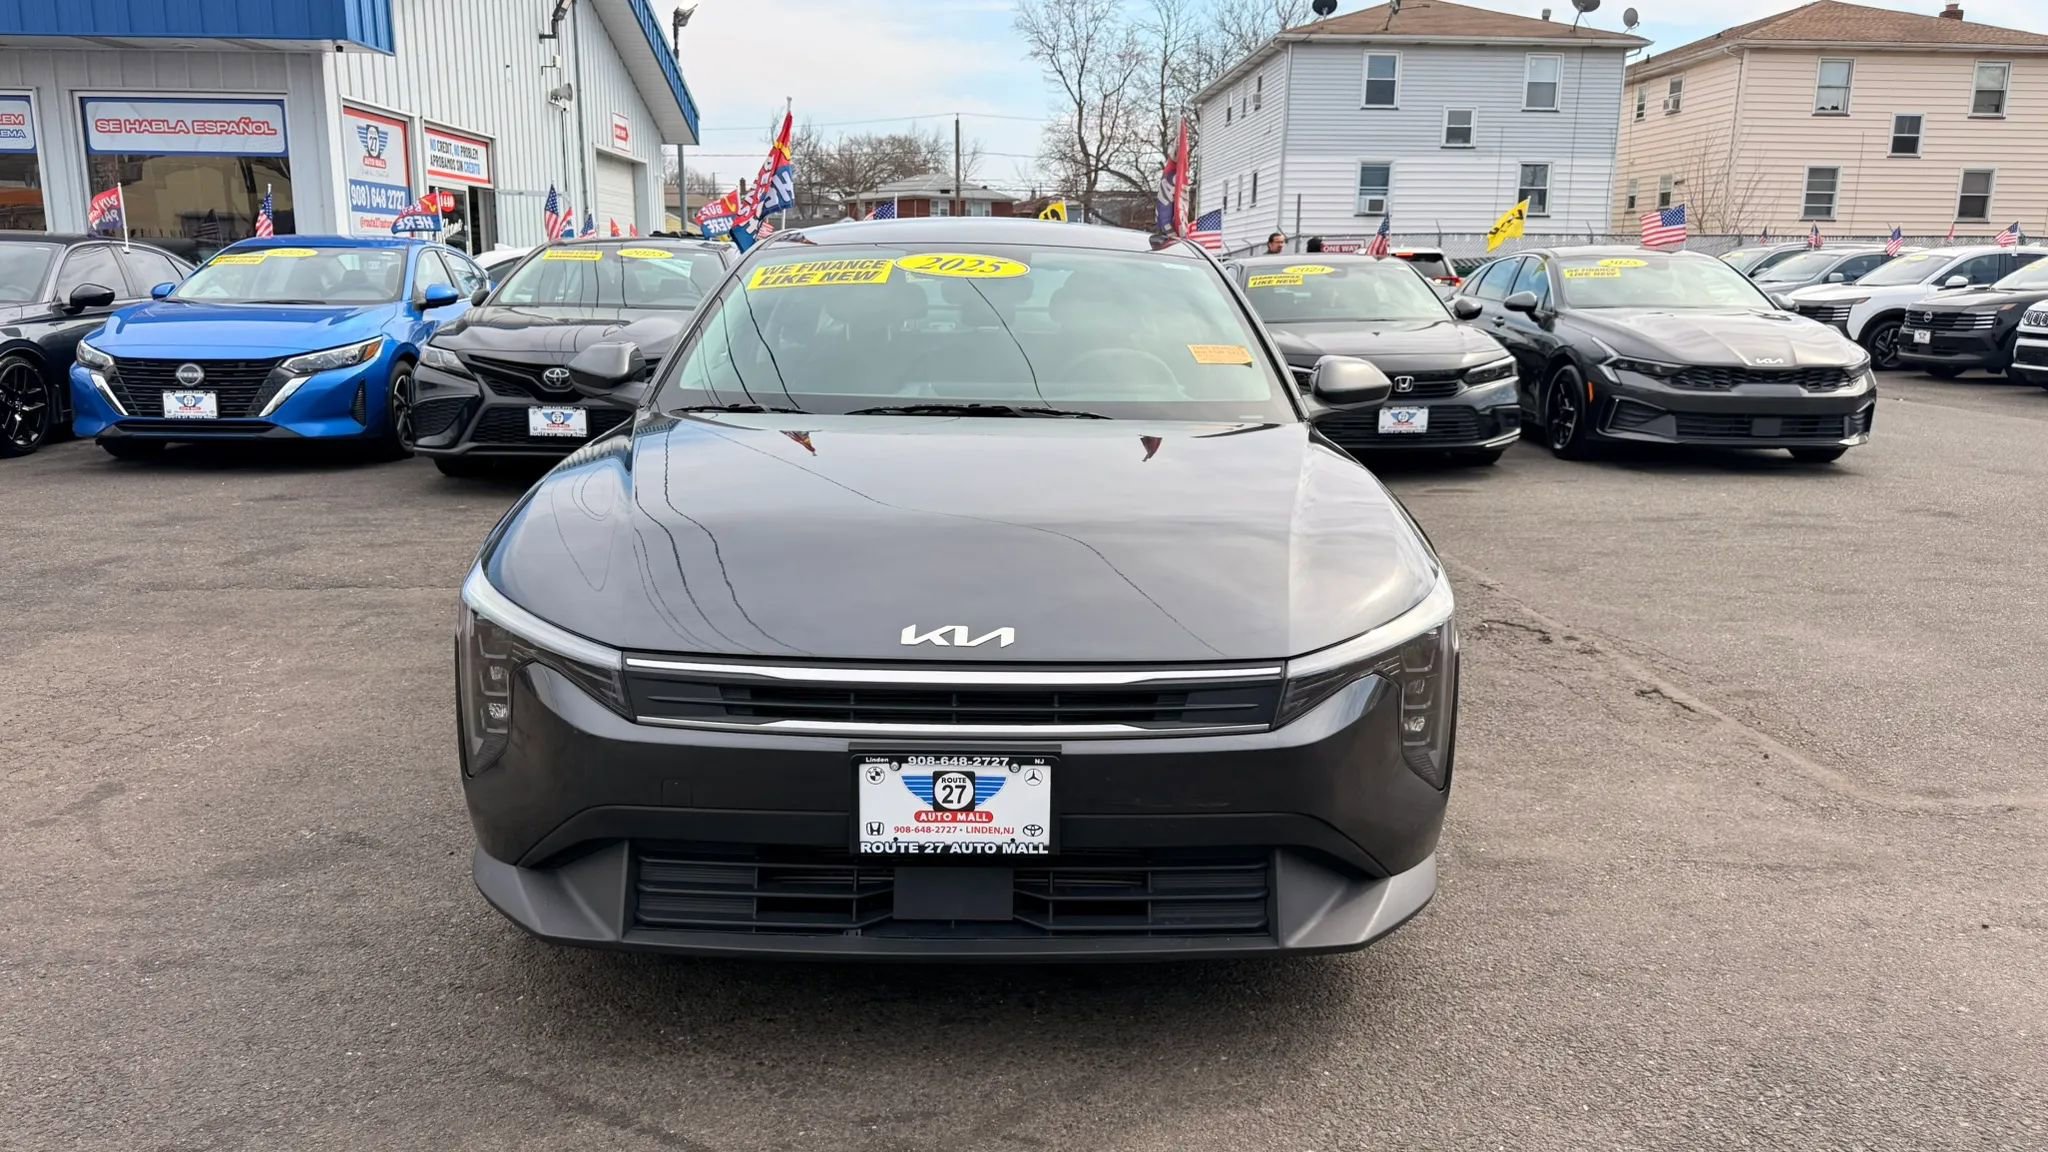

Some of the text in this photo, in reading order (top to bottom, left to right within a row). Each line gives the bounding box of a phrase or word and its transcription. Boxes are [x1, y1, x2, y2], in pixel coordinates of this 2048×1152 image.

[95, 117, 277, 135] SE HABLA ESPAÑOL
[369, 136, 378, 152] 27
[371, 187, 387, 208] 648
[387, 190, 405, 211] 2727
[1323, 244, 1360, 253] ONE WAY
[762, 260, 888, 276] WE FINANCE
[917, 257, 1010, 273] 2025
[758, 271, 882, 286] LIKE NEW
[900, 623, 1015, 648] KIA
[907, 756, 1009, 767] 908-648-2727
[941, 785, 967, 804] 27
[919, 812, 989, 823] AUTO MALL
[893, 825, 1015, 836] 908-648-2727 LINDEN,NJ
[860, 842, 1049, 855] ROUTE 27 AUTO MALL
